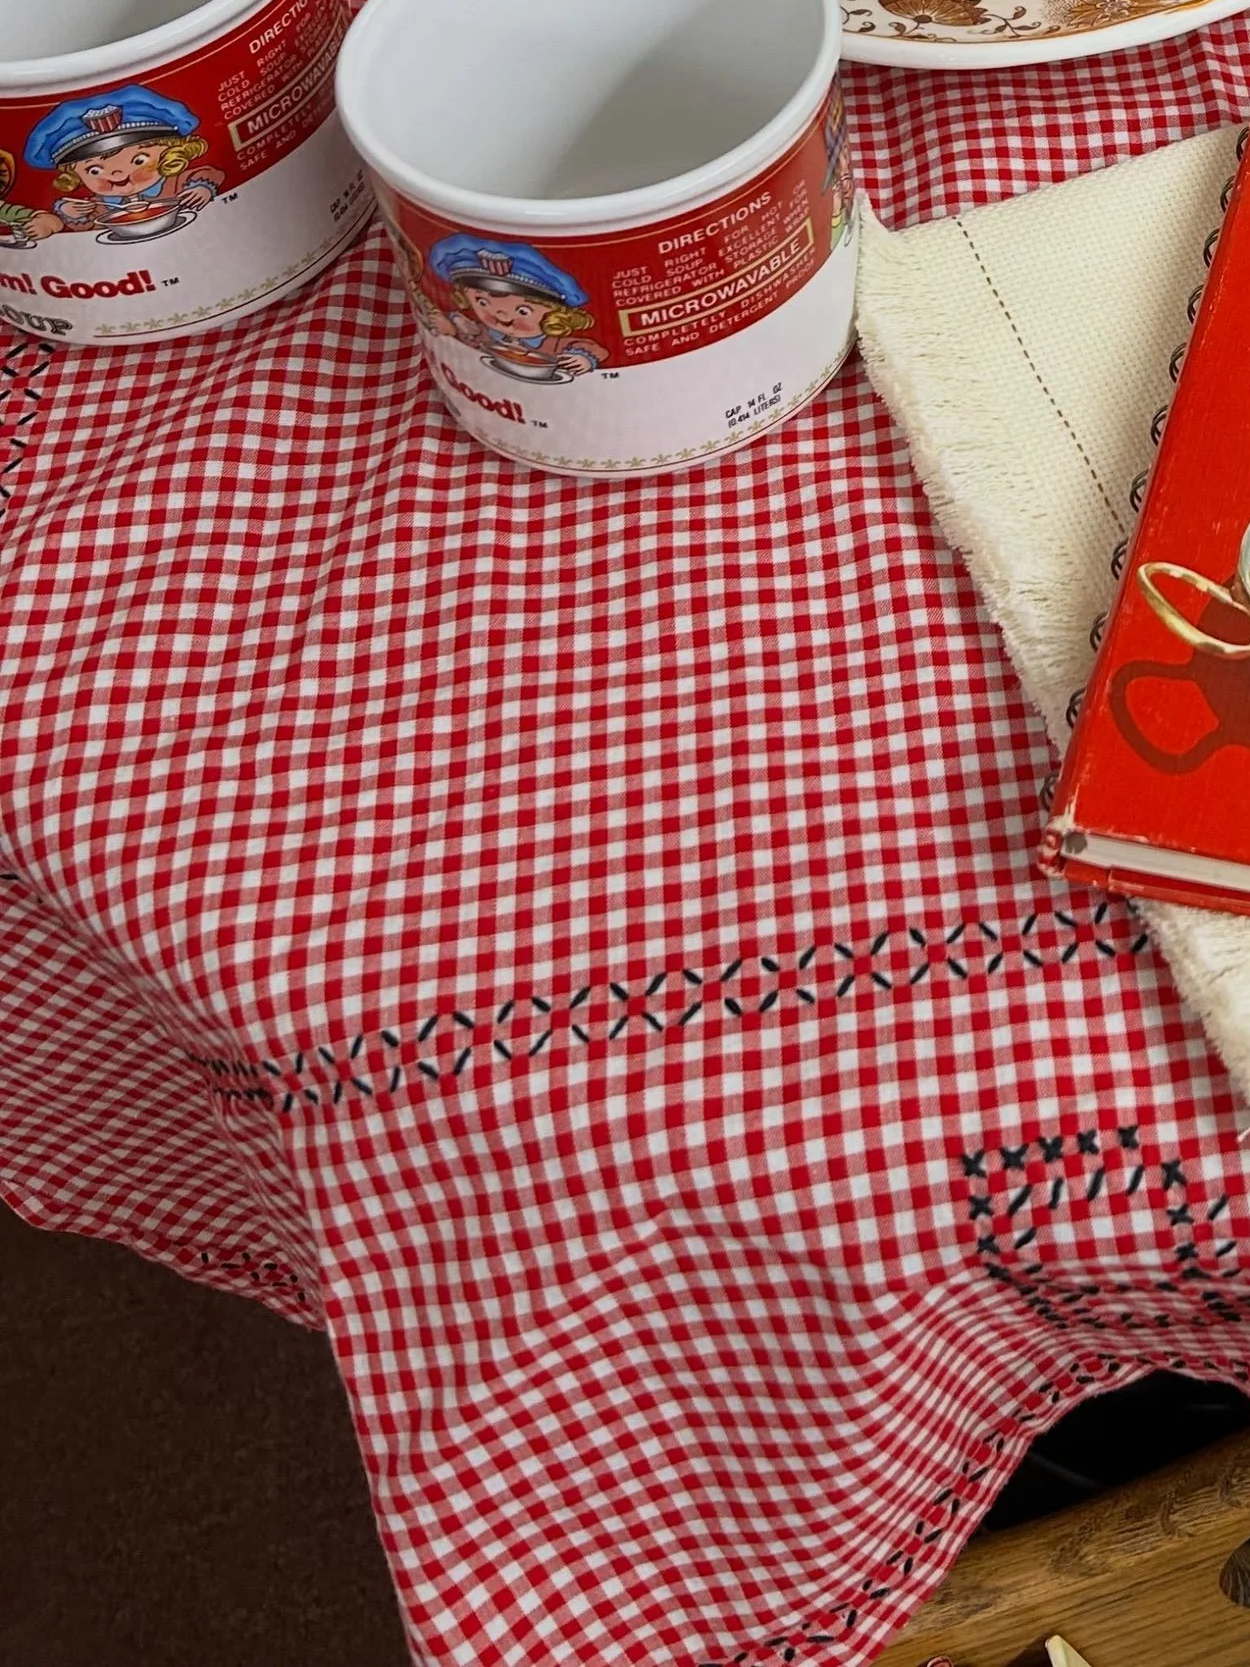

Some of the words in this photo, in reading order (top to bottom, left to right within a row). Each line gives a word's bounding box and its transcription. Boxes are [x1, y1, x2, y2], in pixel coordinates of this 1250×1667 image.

[217, 70, 246, 93] JUST
[256, 38, 287, 68] RIGHT
[217, 79, 251, 102] COLD
[223, 84, 276, 121] COVERED
[239, 149, 268, 171] SAFE
[657, 191, 772, 255] DIRECTIONS
[611, 275, 652, 289] COLD
[666, 258, 704, 277] SOUP
[718, 213, 781, 257] EXCELLENT
[612, 265, 649, 280] JUST
[664, 246, 707, 268] RIGHT
[724, 225, 749, 244] FOR
[613, 262, 717, 298] REFRIGERATOR
[725, 227, 777, 264] STORAGE
[615, 286, 682, 307] COVERED
[691, 268, 725, 287] WITH
[733, 235, 779, 270] PLASTIC
[40, 269, 156, 300] Good!
[640, 238, 801, 326] MICROWAVABLE
[624, 310, 727, 347] COMPLETELY
[625, 342, 660, 357] SAFE
[671, 332, 700, 346] AND
[708, 290, 779, 334] DETERGENT
[725, 405, 742, 419] CAP
